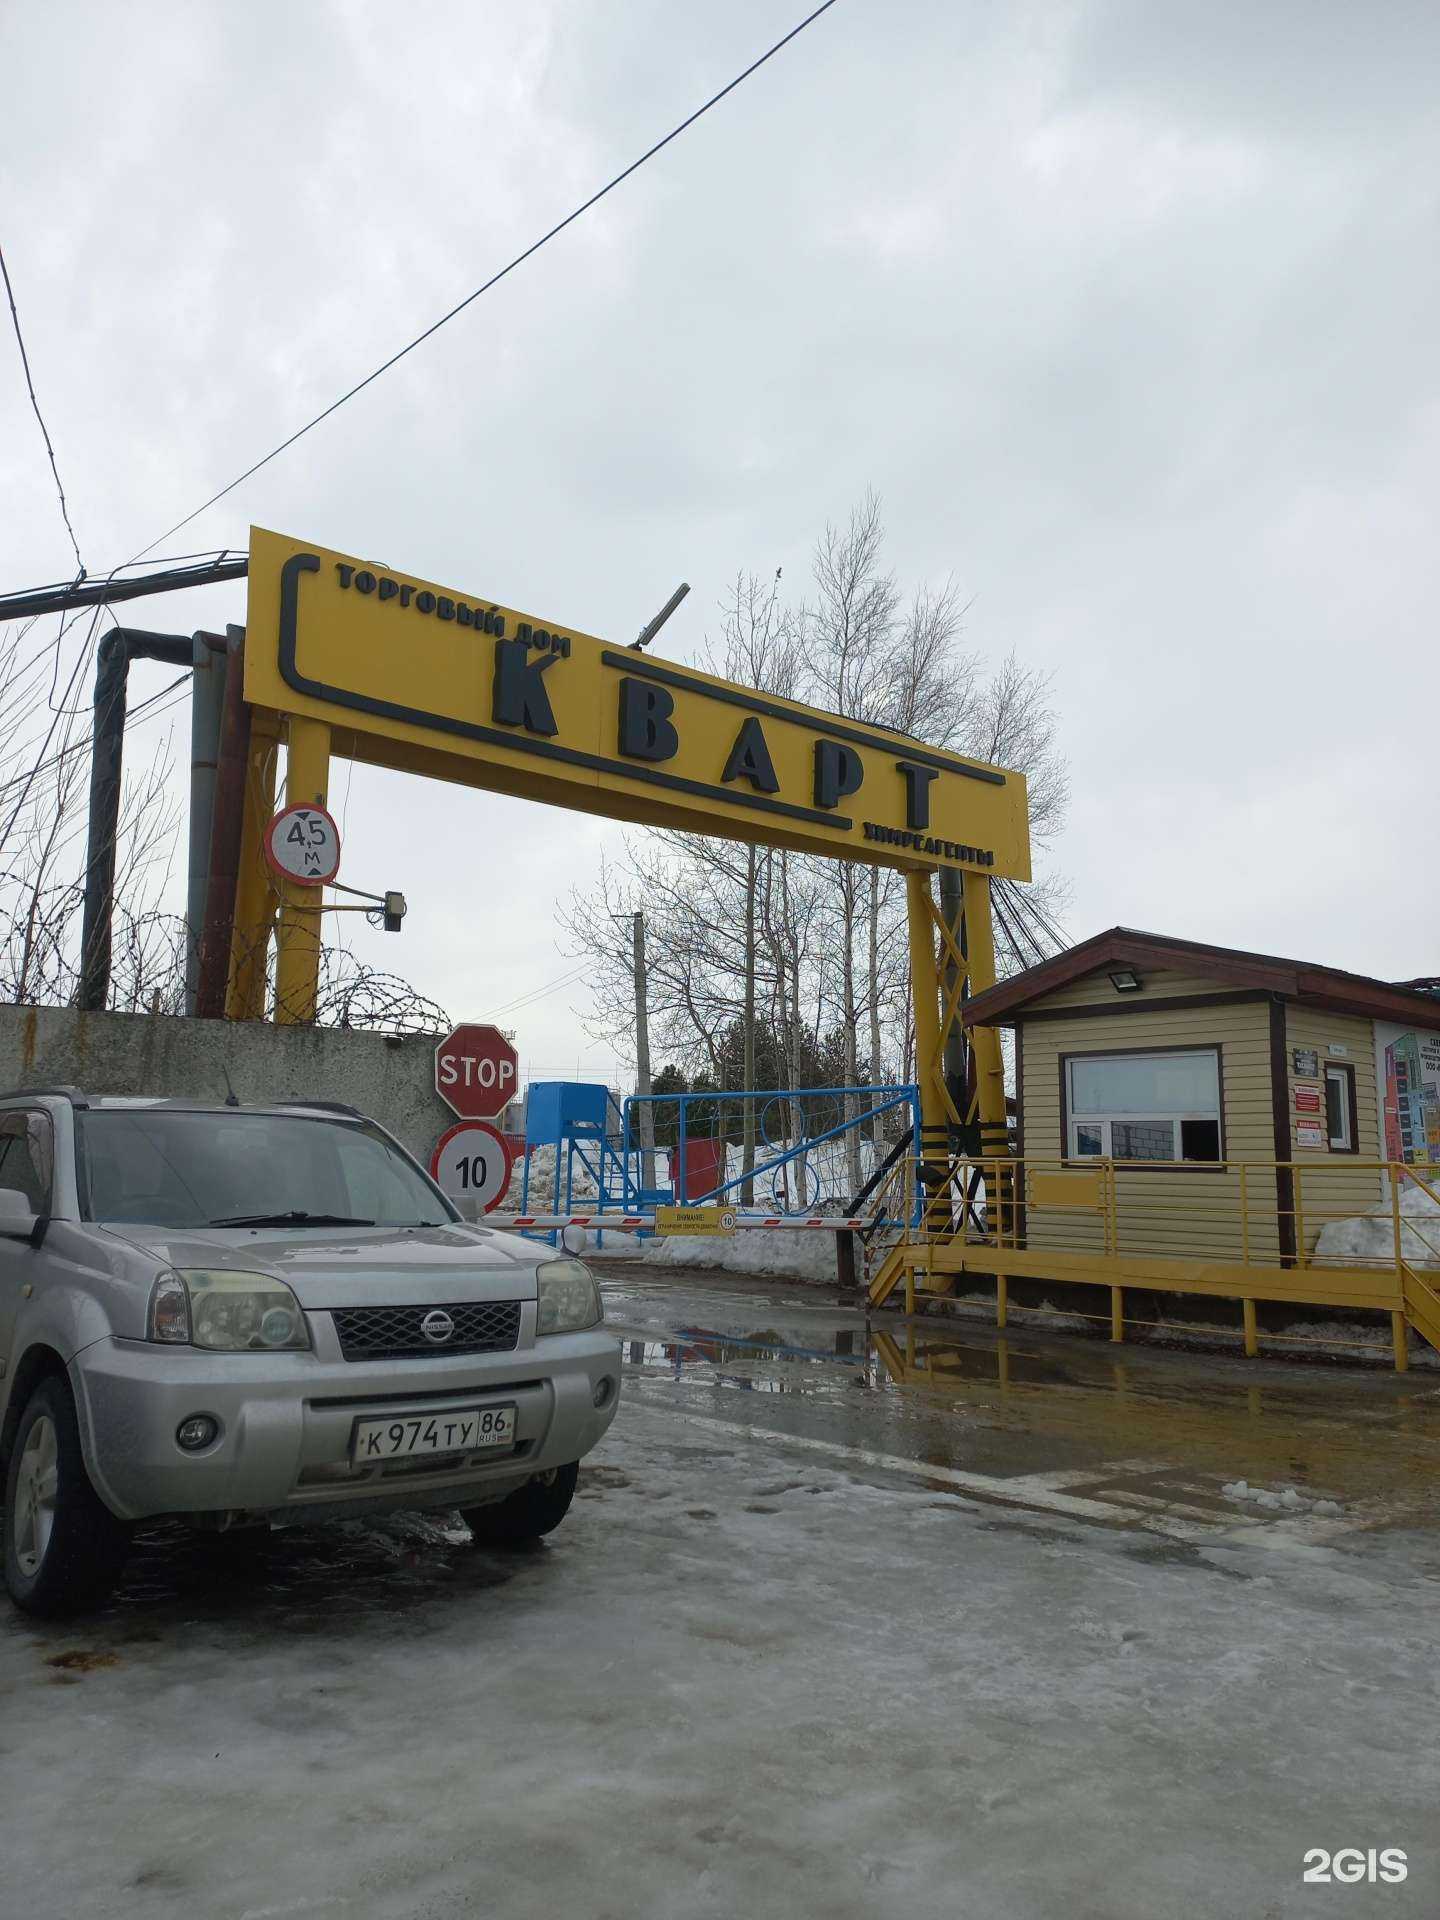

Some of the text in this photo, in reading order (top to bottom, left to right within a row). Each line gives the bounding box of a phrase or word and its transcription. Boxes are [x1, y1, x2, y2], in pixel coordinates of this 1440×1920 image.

[335, 562, 571, 658] ТОРГОВЫЙ ДОМ
[491, 638, 940, 830] КВАРТ
[287, 820, 327, 849] 4,5
[440, 1054, 514, 1090] STOP
[455, 1156, 487, 1189] 10
[479, 1434, 498, 1443] RUS
[481, 1411, 506, 1434] 86
